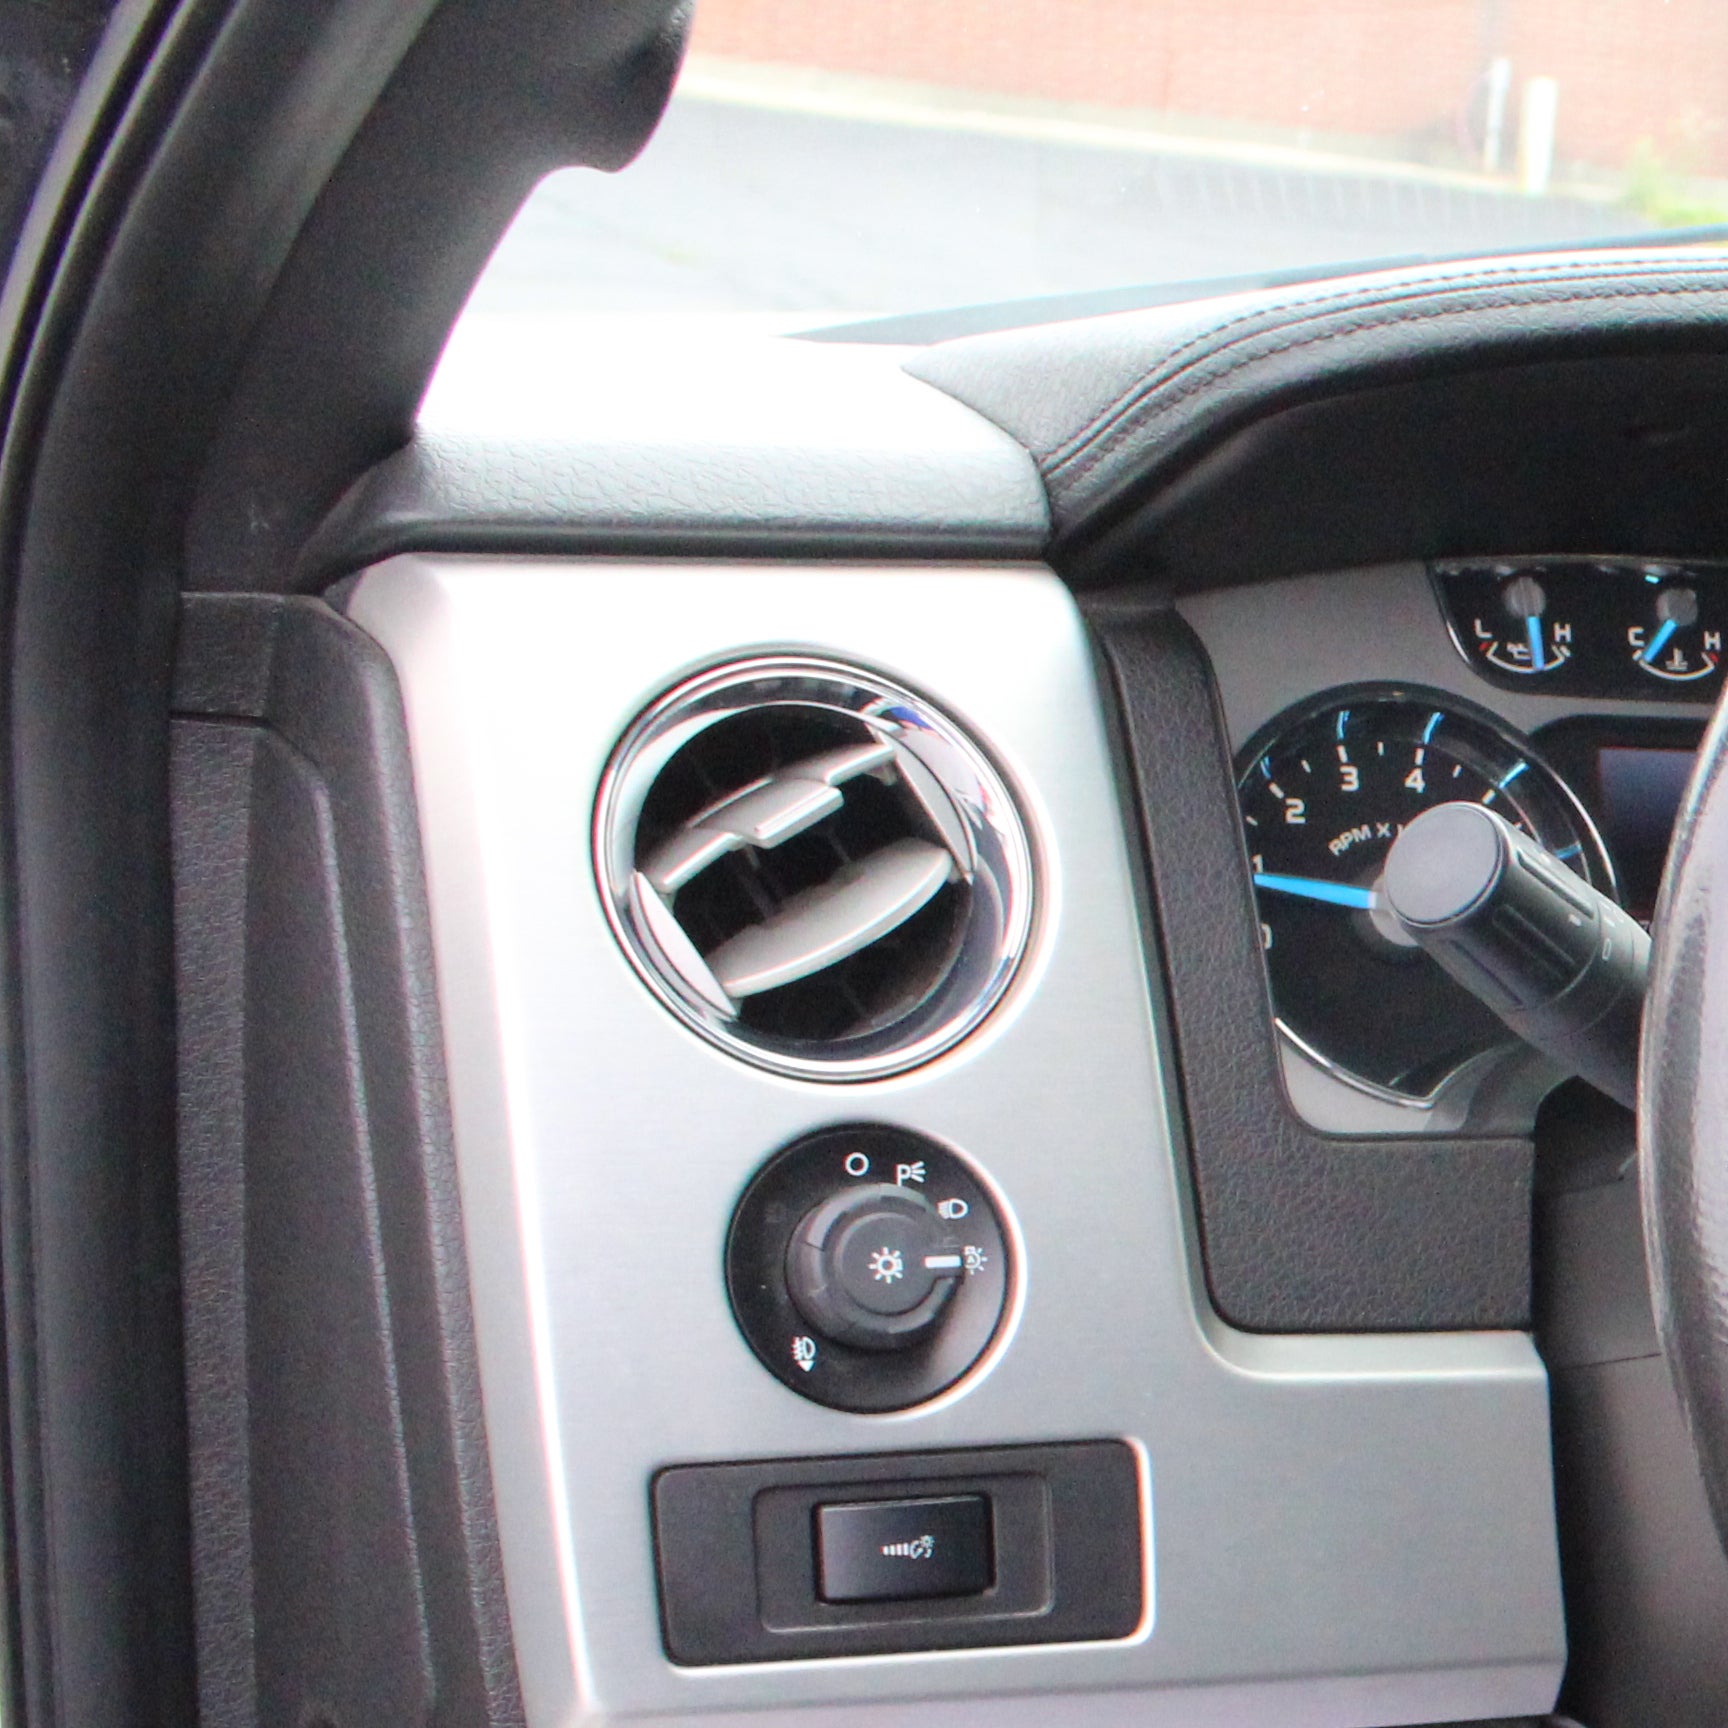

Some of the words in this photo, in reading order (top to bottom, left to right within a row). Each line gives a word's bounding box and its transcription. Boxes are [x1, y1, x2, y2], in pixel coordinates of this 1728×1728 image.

[1474, 618, 1493, 638] L
[1553, 622, 1572, 643] H
[1627, 626, 1645, 647] C
[1703, 631, 1721, 650] H
[1339, 765, 1360, 792] 3
[1404, 768, 1426, 793] 4
[1284, 798, 1306, 824] 2
[1328, 822, 1371, 857] RPM
